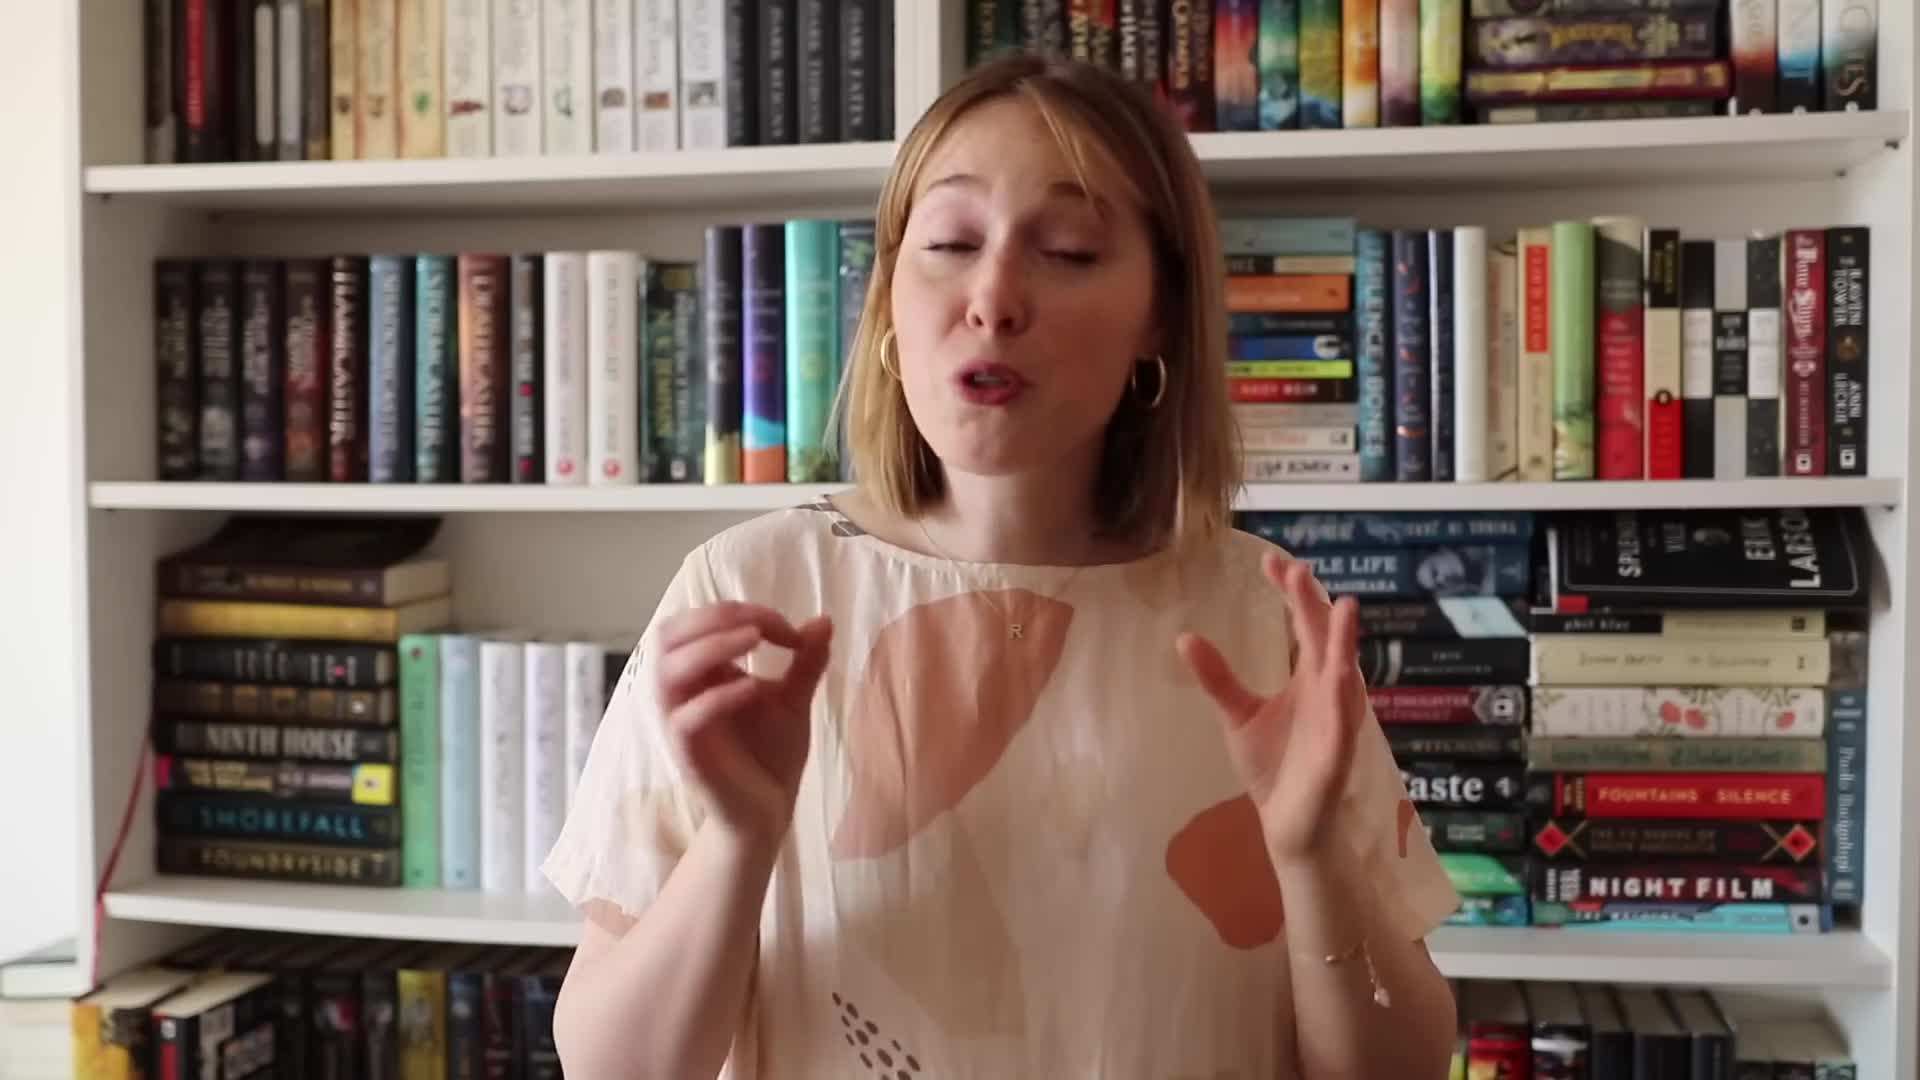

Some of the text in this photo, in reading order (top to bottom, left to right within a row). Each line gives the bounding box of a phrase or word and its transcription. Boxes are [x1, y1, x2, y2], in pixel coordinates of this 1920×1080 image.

[1780, 508, 1822, 589] LARSO
[1350, 556, 1397, 574] LIFE
[1008, 624, 1023, 640] R
[1598, 788, 1698, 802] FOUNTAINS
[1715, 789, 1792, 804] SILENCE
[1589, 877, 1686, 897] NIGHT
[1696, 877, 1774, 899] FILM
